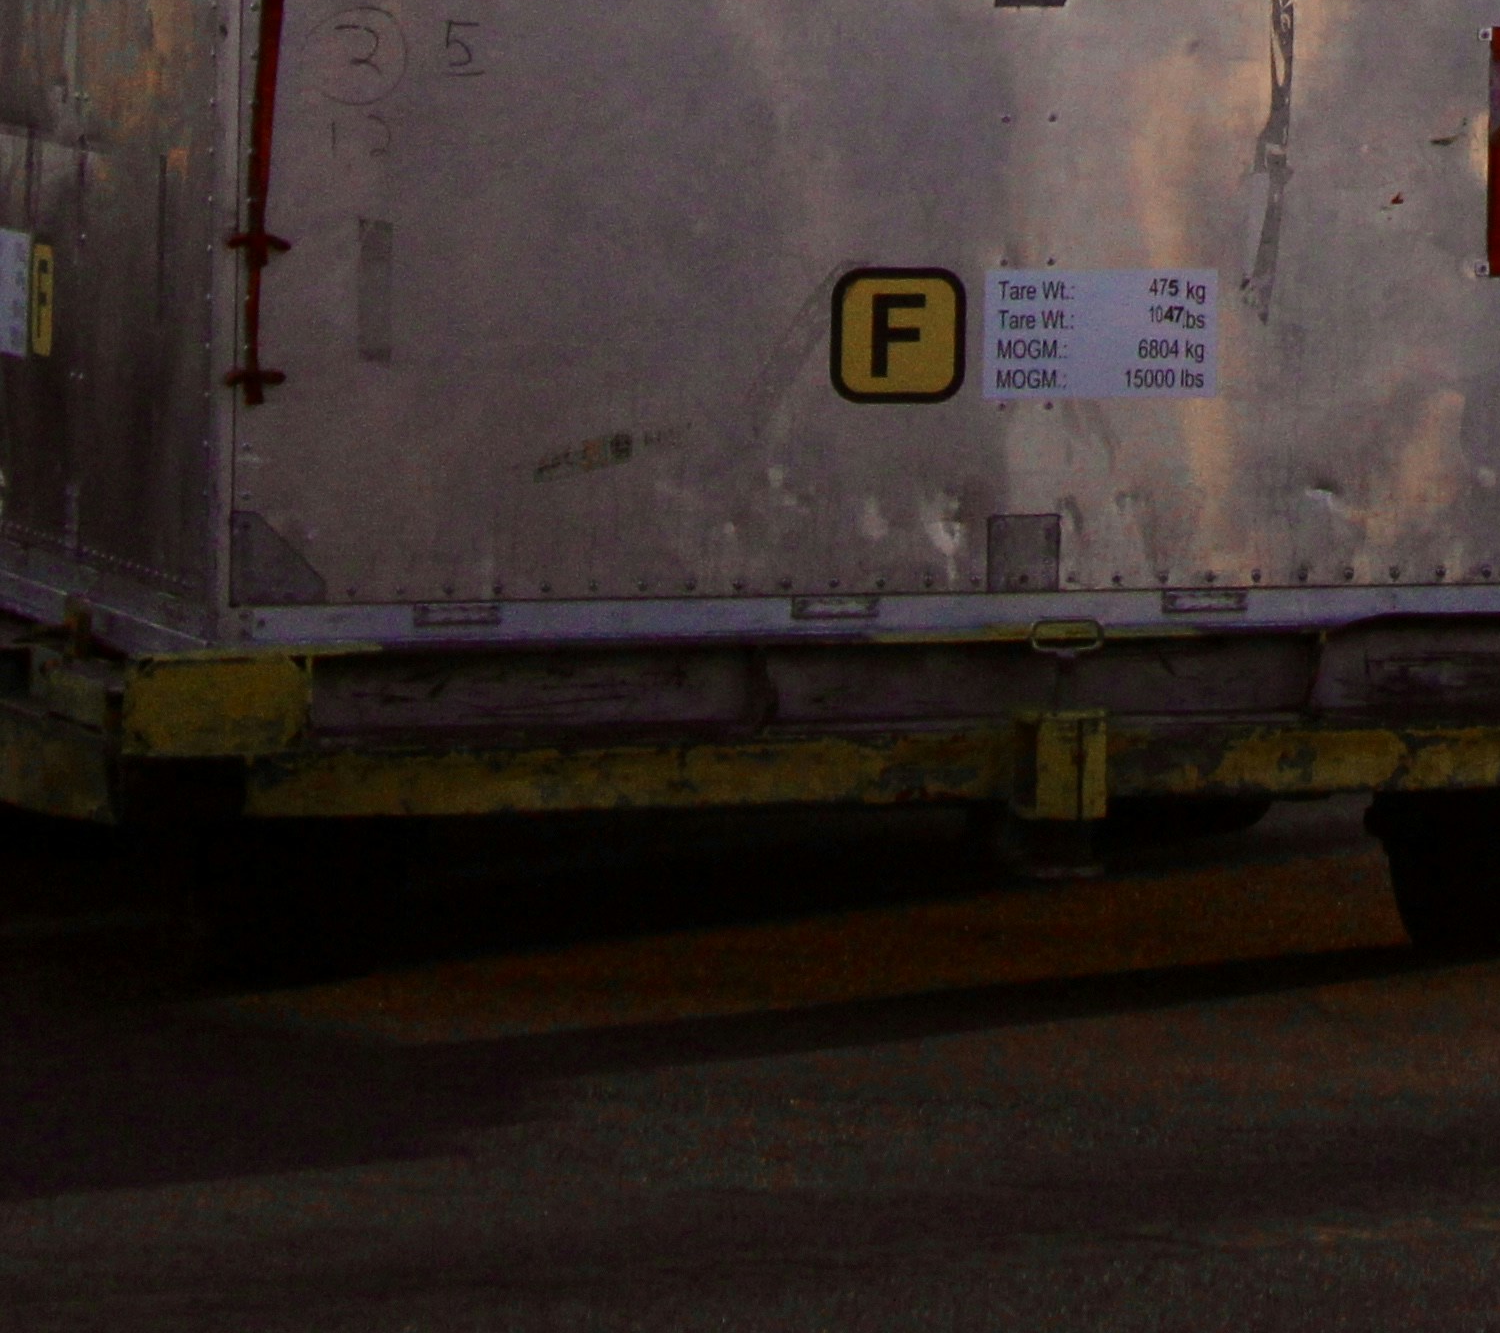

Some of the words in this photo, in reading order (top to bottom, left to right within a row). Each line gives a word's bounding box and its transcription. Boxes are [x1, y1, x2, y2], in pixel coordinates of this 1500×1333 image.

[998, 280, 1037, 300] Tare
[1149, 278, 1179, 297] 475
[1186, 282, 1207, 304] kg
[998, 309, 1036, 329] Tare
[1149, 305, 1185, 324] 1047
[870, 292, 927, 378] F
[1138, 339, 1179, 359] 6804
[1185, 340, 1205, 363] kg
[1125, 369, 1176, 388] 15000
[1181, 369, 1205, 389] lbs
